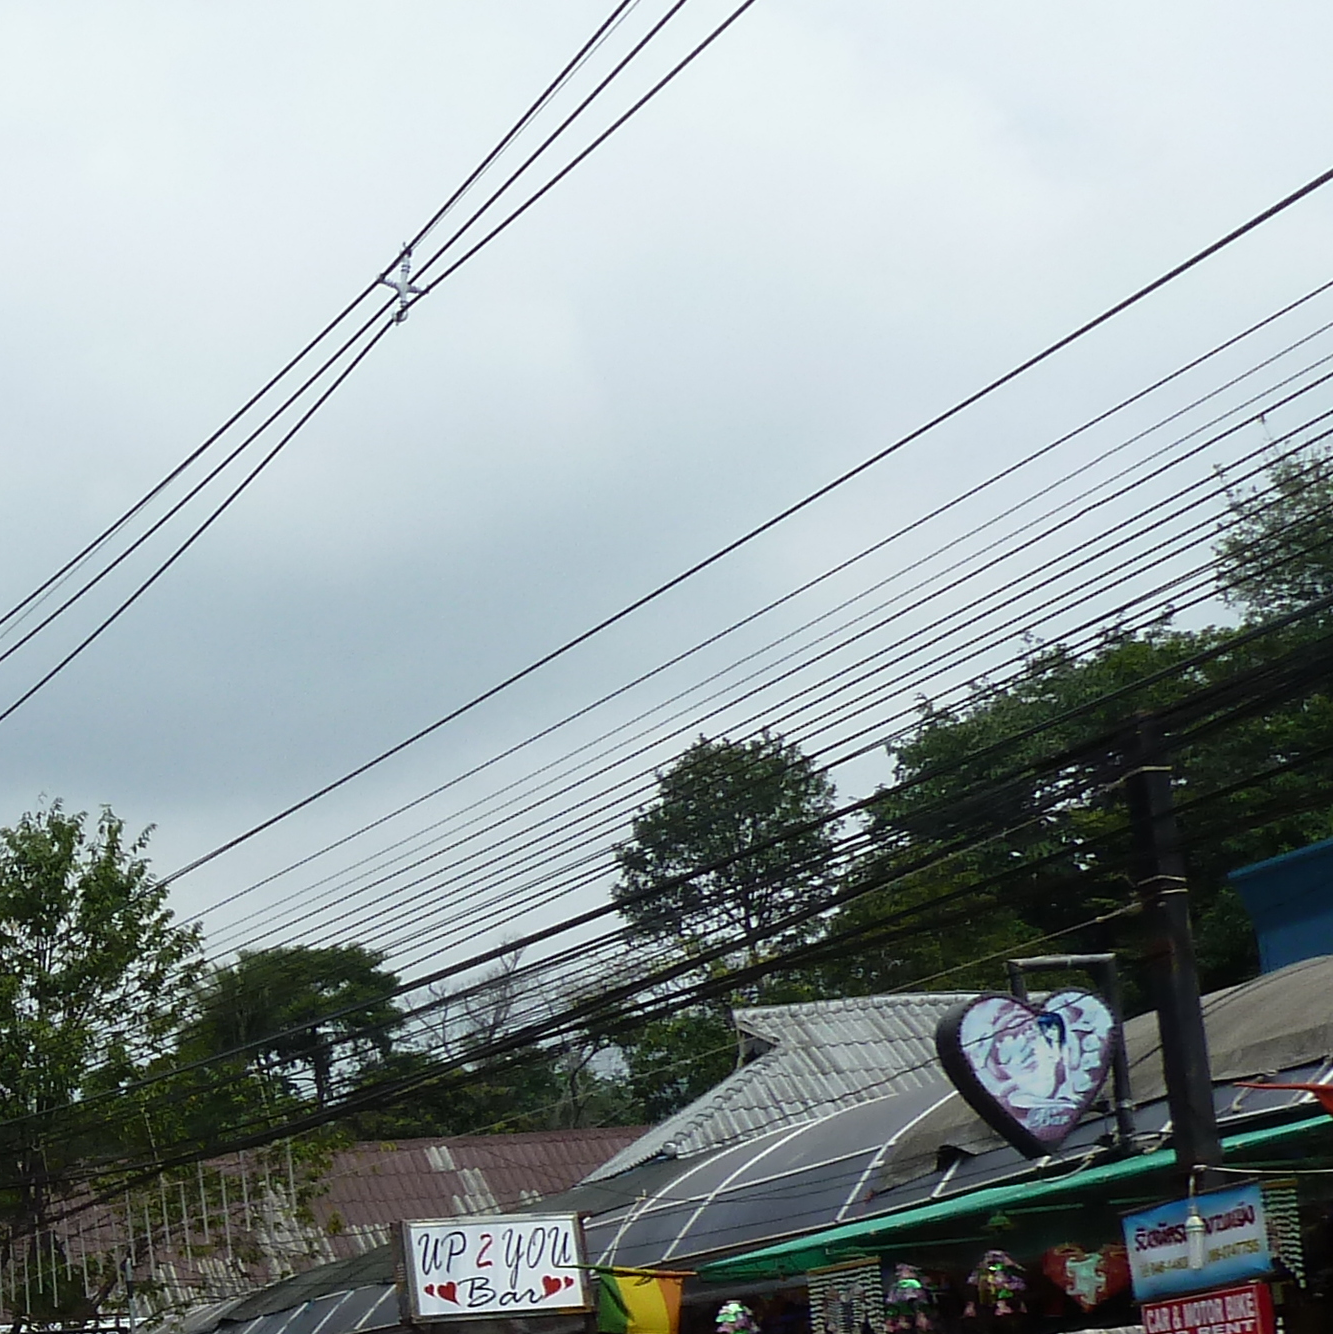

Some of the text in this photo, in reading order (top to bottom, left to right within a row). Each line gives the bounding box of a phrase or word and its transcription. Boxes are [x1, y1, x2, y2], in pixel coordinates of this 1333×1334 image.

[418, 1226, 572, 1289] UP 2 YOU
[458, 1276, 544, 1307] Bar
[1147, 1292, 1256, 1334] CAR & MOTOR BIKE
